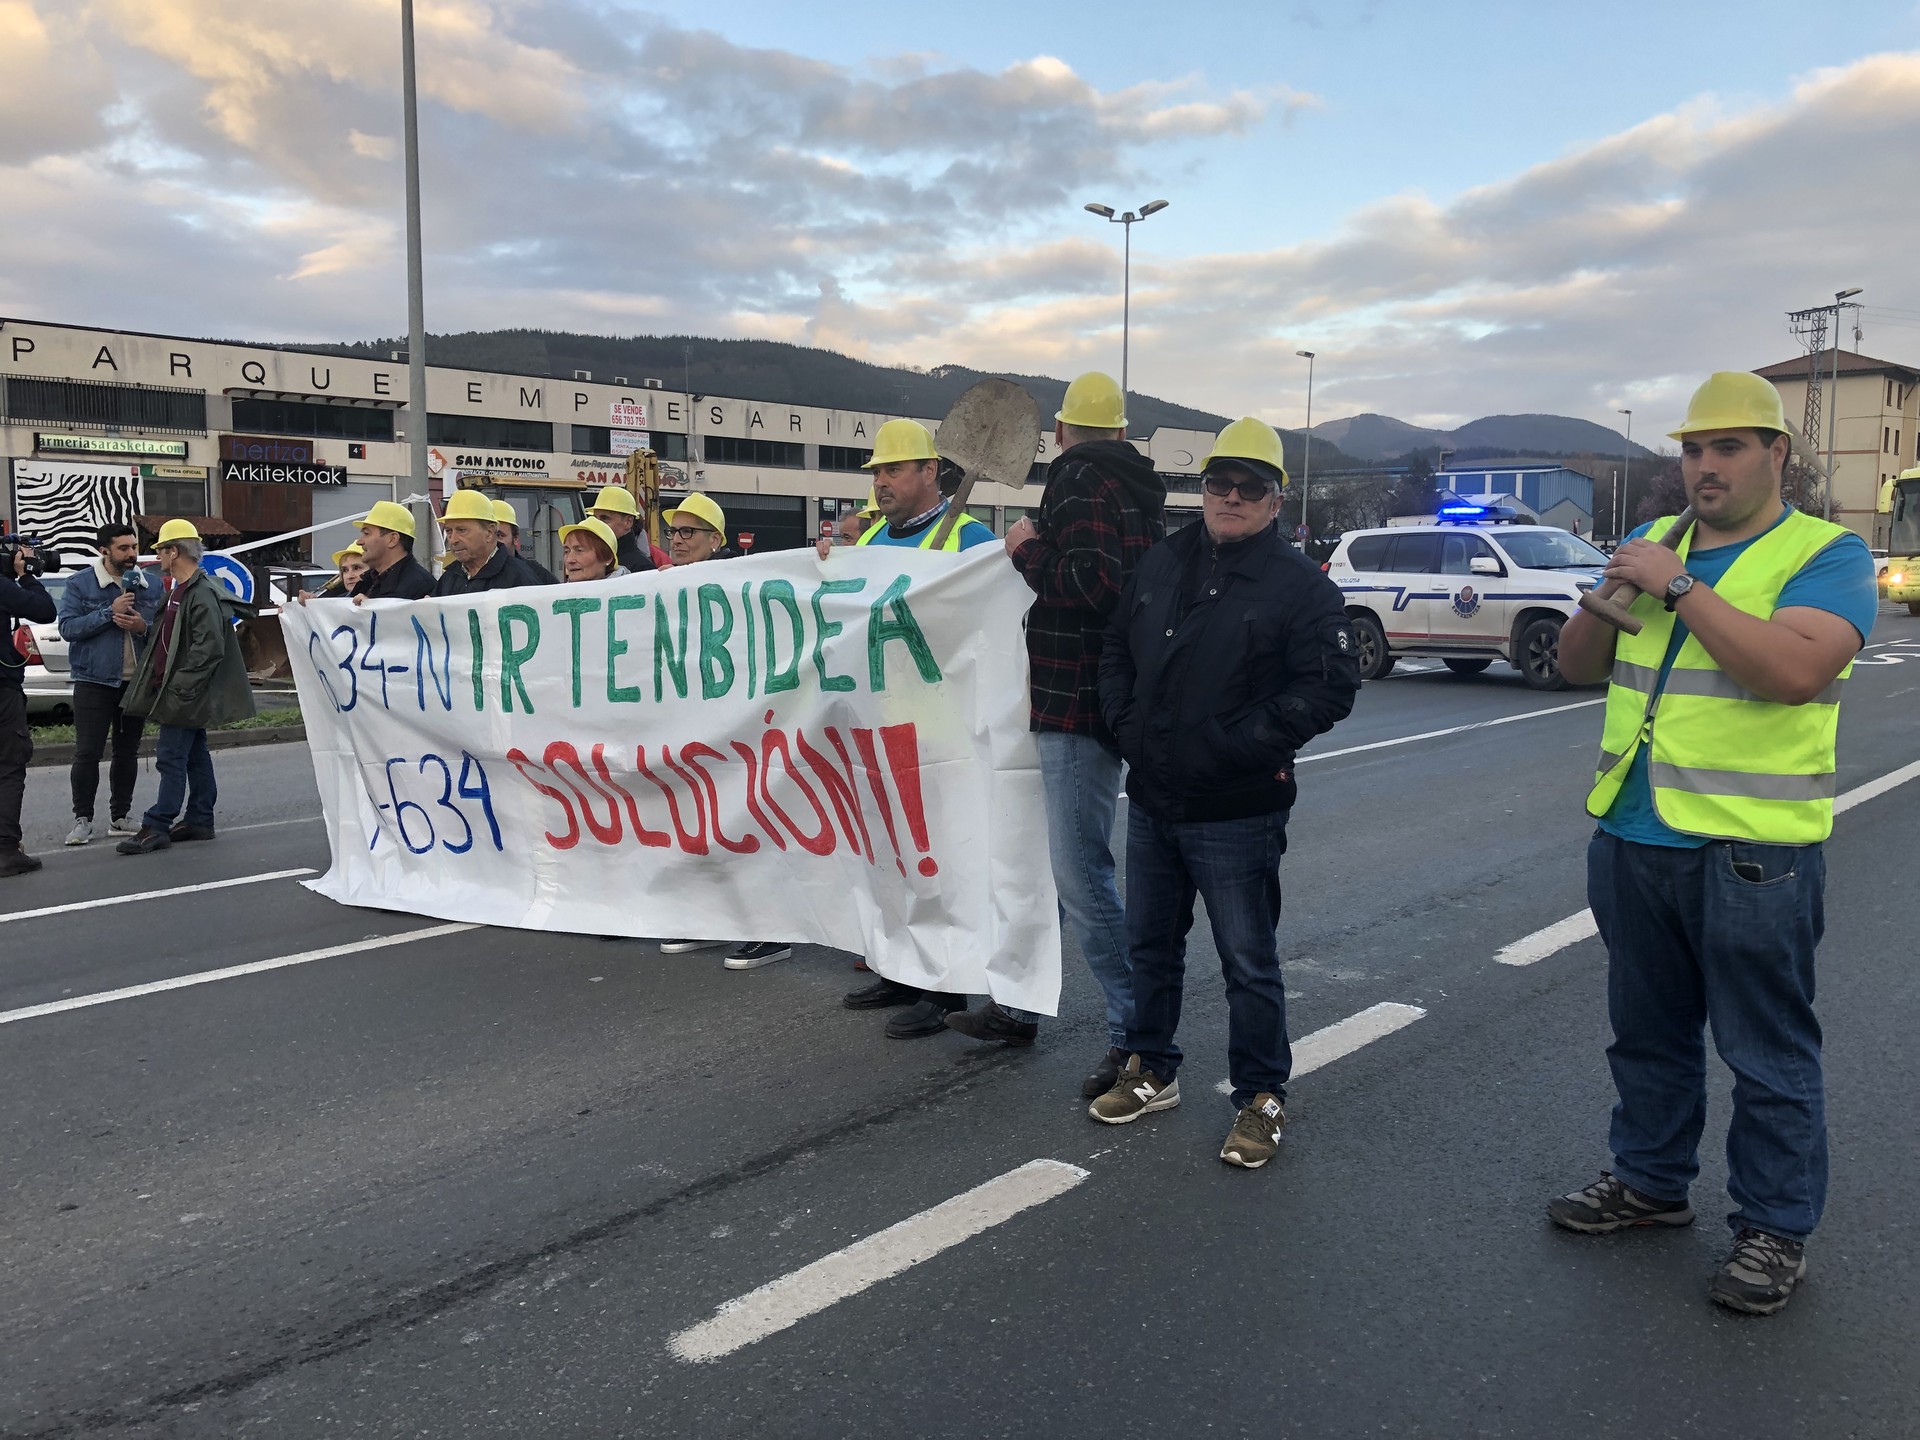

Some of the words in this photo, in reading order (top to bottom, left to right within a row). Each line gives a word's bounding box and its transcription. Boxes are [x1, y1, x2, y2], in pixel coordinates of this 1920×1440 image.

[12, 337, 390, 395] PARQUE
[614, 405, 621, 414] SE
[623, 406, 642, 415] VENDE
[612, 415, 622, 424] 656
[624, 416, 633, 425] 793
[636, 417, 645, 426] 750
[39, 434, 183, 454] armeriasarasketa.com
[232, 439, 307, 462] hertza
[456, 455, 482, 466] SAN
[486, 456, 545, 469] ANTONIO
[226, 463, 341, 485] Arkitektoak
[577, 471, 607, 483] SAN
